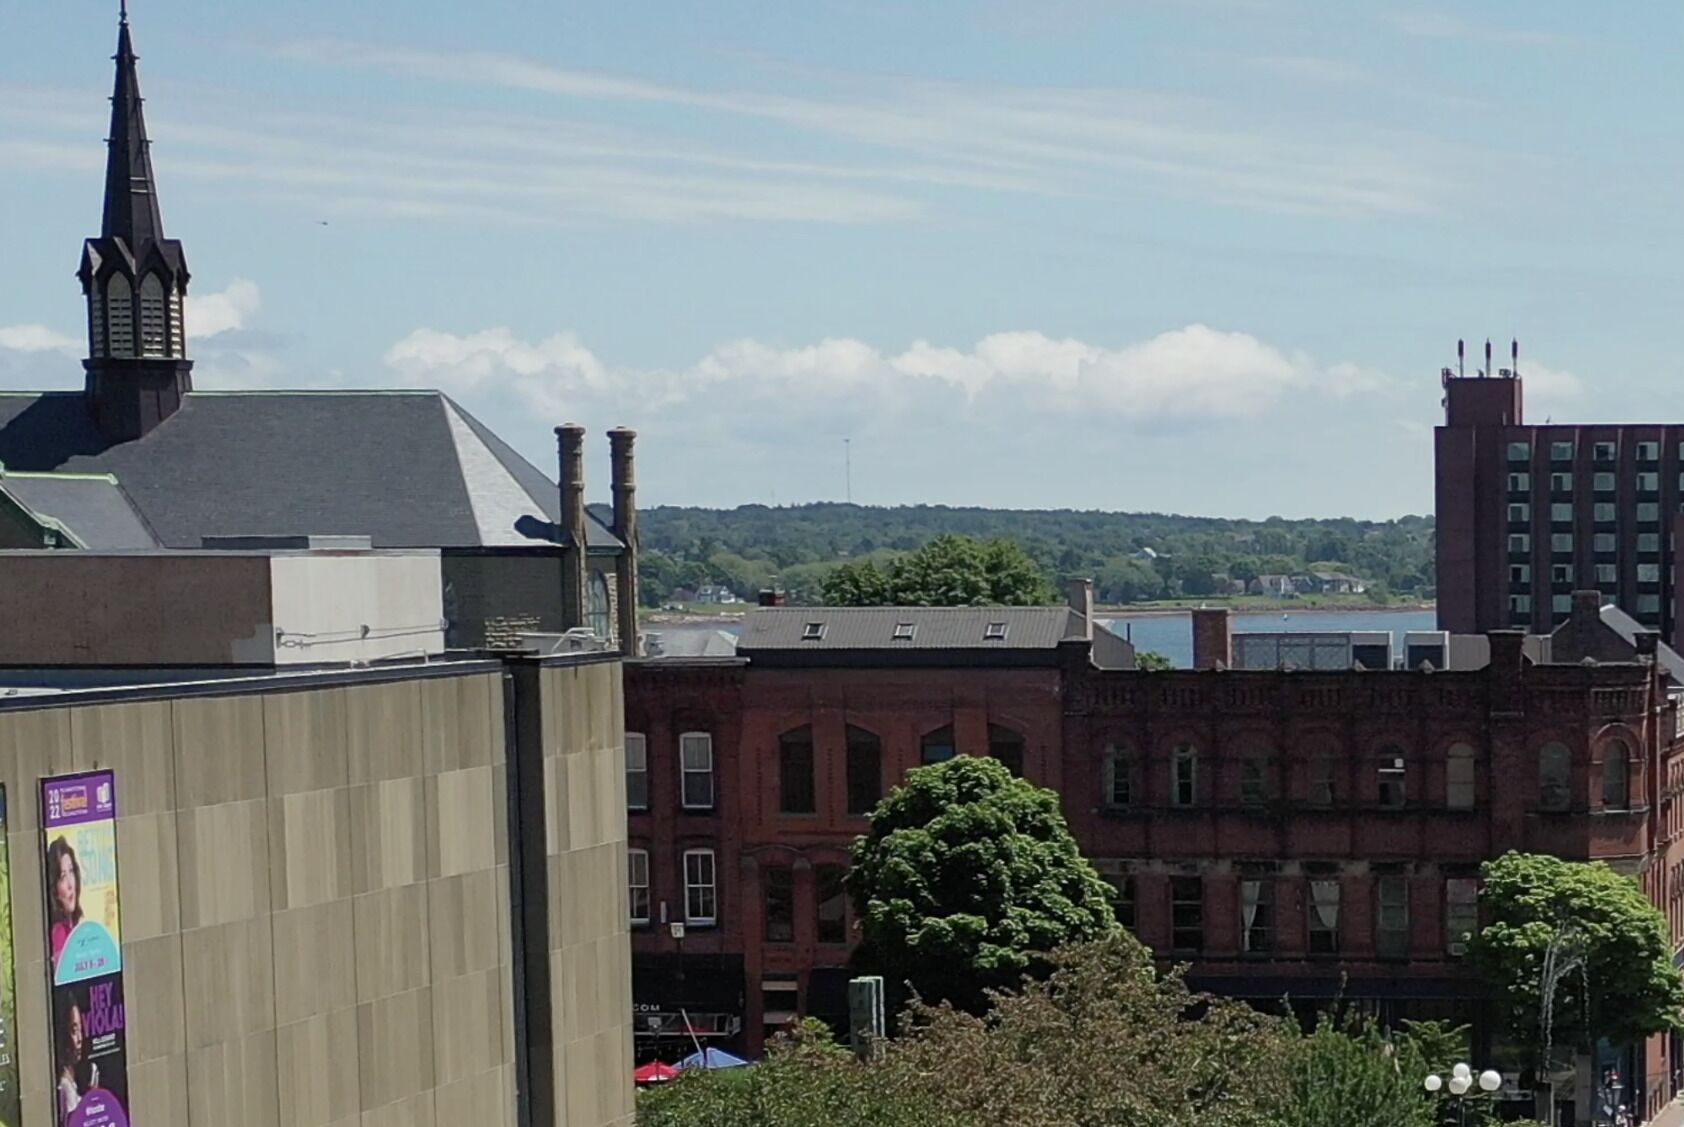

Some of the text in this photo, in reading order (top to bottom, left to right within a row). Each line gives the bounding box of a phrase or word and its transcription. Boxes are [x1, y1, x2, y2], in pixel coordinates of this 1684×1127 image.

[48, 788, 59, 804] 20
[50, 803, 60, 819] 22
[90, 981, 113, 1010] HEY
[82, 1003, 123, 1037] VIOLA!
